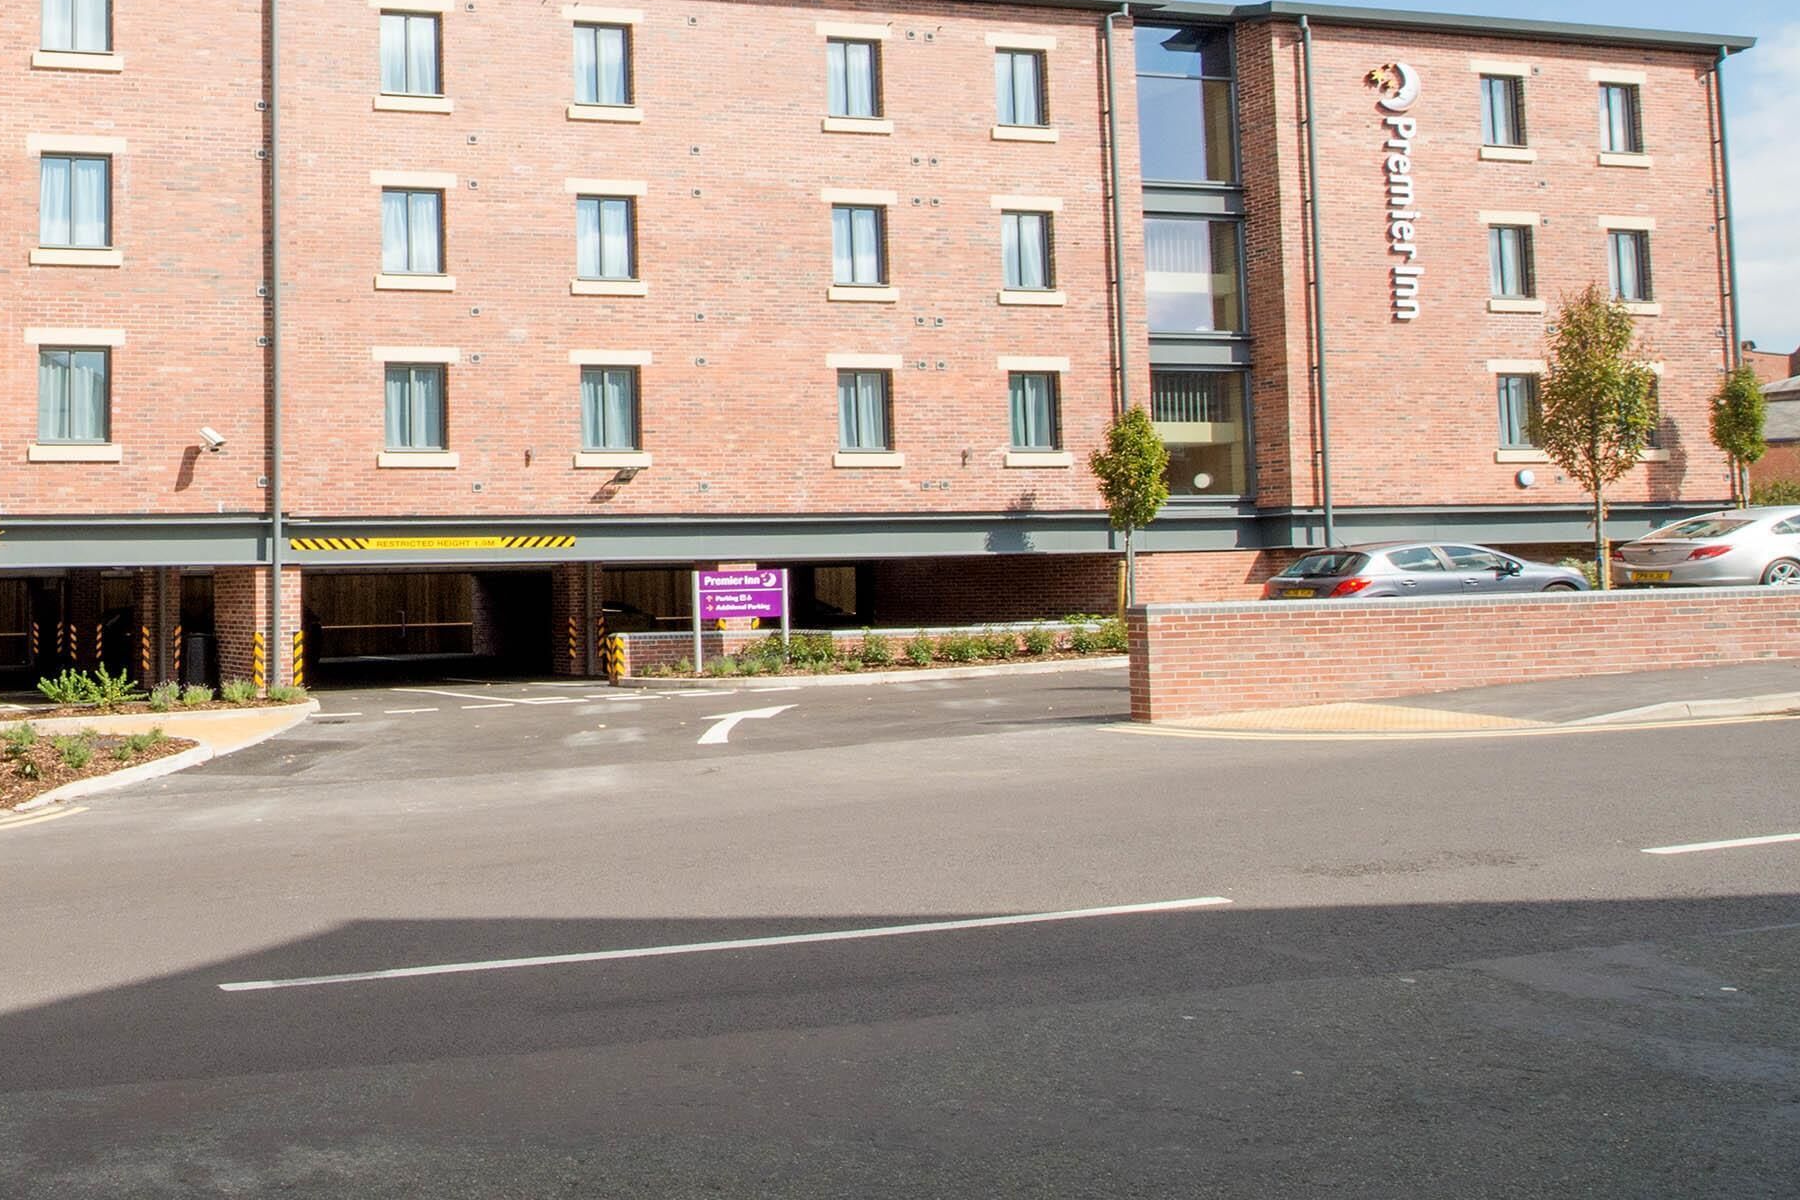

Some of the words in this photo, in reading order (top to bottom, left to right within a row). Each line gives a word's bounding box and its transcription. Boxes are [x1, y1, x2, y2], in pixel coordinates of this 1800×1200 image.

[1385, 116, 1421, 260] Premier
[1393, 266, 1424, 320] Inn
[376, 540, 434, 548] RESTRICTED
[704, 576, 743, 586] Premier
[744, 575, 760, 585] Inn
